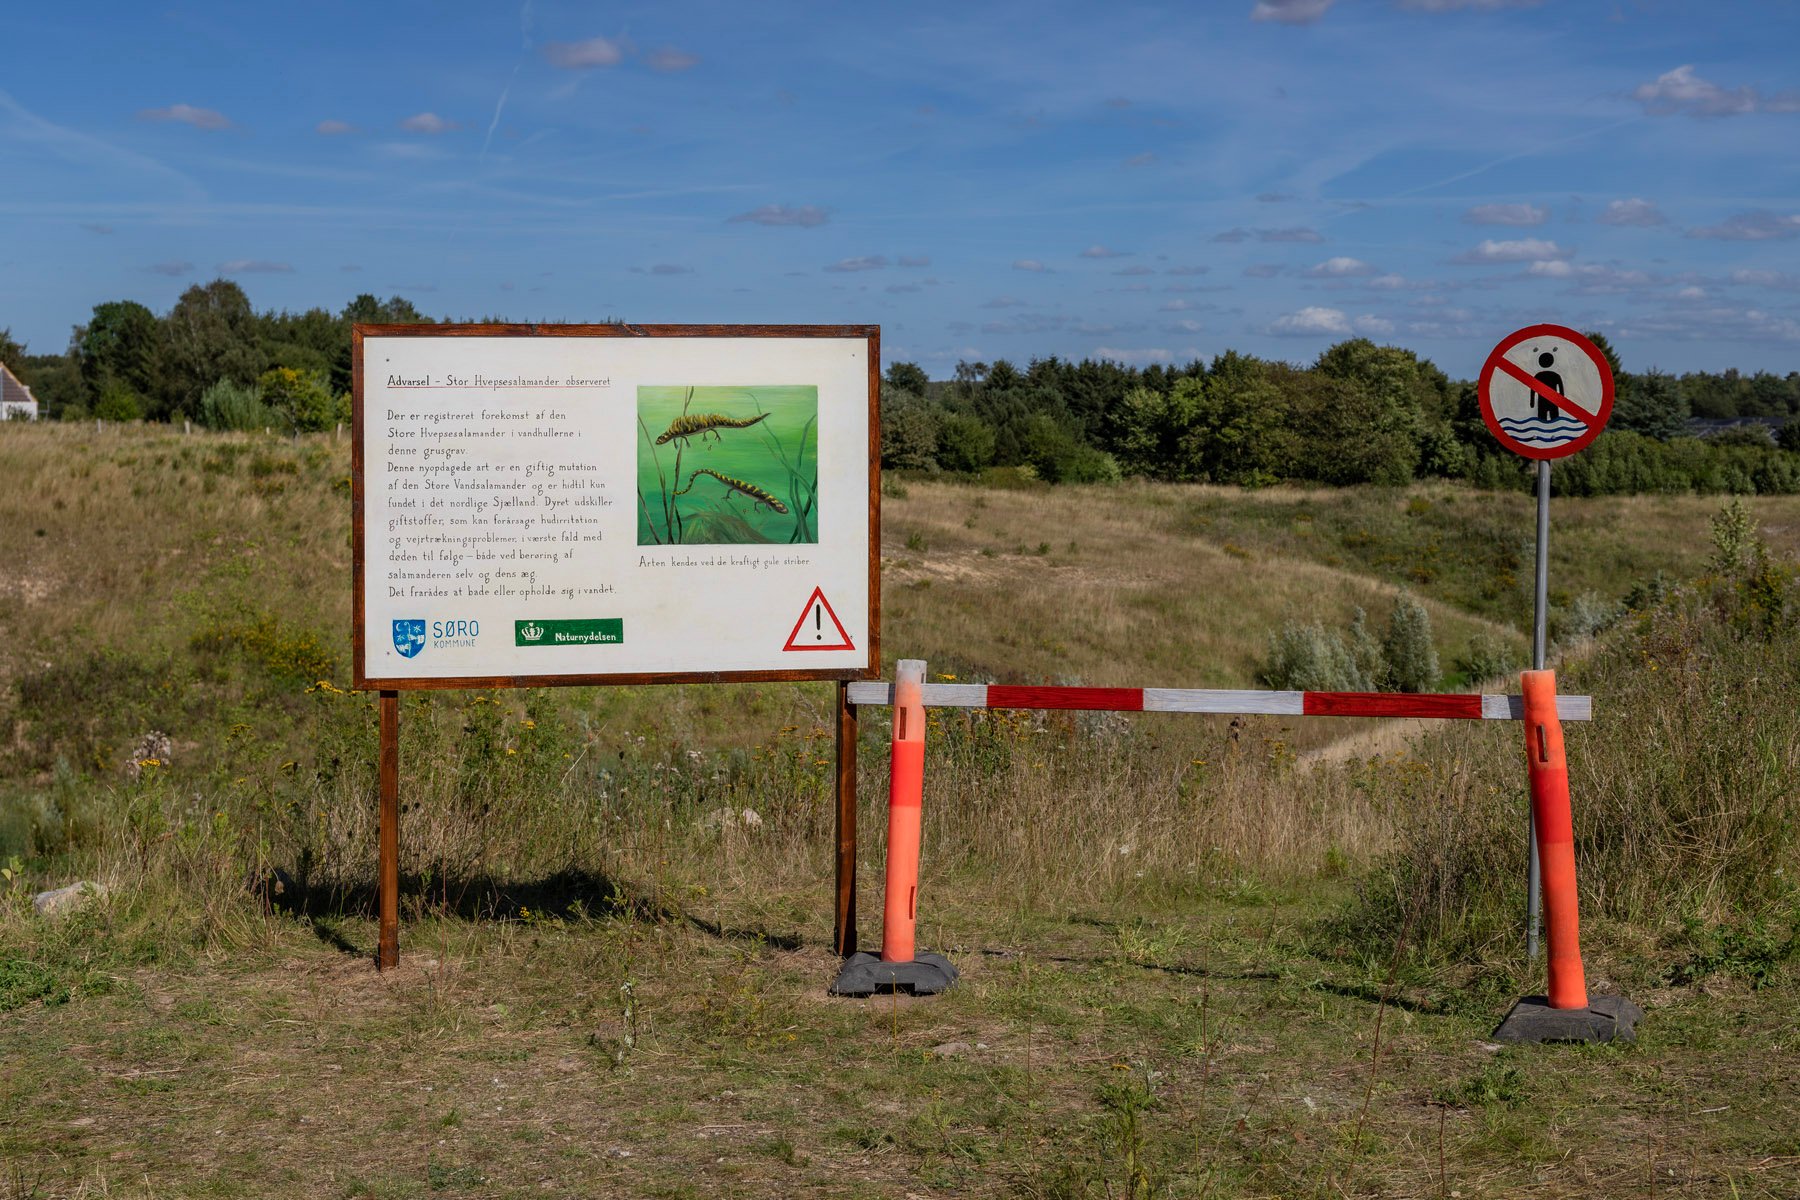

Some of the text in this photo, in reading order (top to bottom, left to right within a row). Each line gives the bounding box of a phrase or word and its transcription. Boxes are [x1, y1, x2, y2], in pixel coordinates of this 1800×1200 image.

[387, 375, 430, 386] Advarsel
[446, 375, 469, 386] Stor
[474, 375, 559, 390] Hvepsesalamander
[566, 374, 611, 386] observeret
[387, 409, 405, 420] Der
[424, 411, 474, 424] registreret
[482, 409, 529, 419] forekomst
[536, 409, 545, 419] af
[550, 409, 566, 420] den
[388, 427, 415, 437] Store
[421, 427, 505, 443] Hvepsesalamander
[518, 427, 574, 437] vandhullerne
[388, 443, 416, 455] denne
[388, 462, 414, 472] Denne
[419, 461, 471, 477] nyopdagede
[477, 462, 489, 471] art
[526, 461, 554, 477] giftig
[559, 463, 597, 471] mutation
[388, 479, 399, 490] af
[402, 479, 418, 489] den
[425, 479, 449, 489] Store
[454, 479, 526, 489] Vandsalamander
[532, 484, 543, 496] og
[563, 479, 584, 489] hidtil
[590, 479, 605, 488] kun
[389, 497, 416, 507] fundet
[430, 497, 444, 507] det
[450, 497, 488, 513] nordlige
[545, 496, 569, 510] Dyret
[575, 496, 612, 506] udskiller
[472, 514, 488, 524] kan
[494, 514, 535, 529] forårsage
[541, 514, 597, 524] hudirritation
[389, 537, 401, 549] og
[527, 534, 556, 542] værste
[562, 531, 578, 541] fald
[584, 531, 602, 541] med
[389, 550, 417, 561] døden
[423, 550, 433, 560] til
[440, 550, 463, 566] følge
[476, 549, 496, 560] både
[500, 549, 515, 559] ved
[519, 549, 558, 563] berøring
[564, 548, 573, 558] af
[639, 556, 665, 567] Arten
[672, 556, 697, 566] kendes
[701, 556, 714, 566] ved
[717, 556, 726, 565] de
[731, 555, 759, 569] kraftigt
[764, 556, 779, 569] gule
[388, 568, 451, 579] salamanderen
[456, 568, 473, 578] selv
[479, 572, 490, 584] og
[495, 567, 516, 578] dens
[389, 586, 404, 597] Det
[411, 586, 448, 597] frarådes
[453, 587, 462, 596] at
[468, 585, 489, 596] bade
[494, 585, 515, 595] eller
[520, 585, 555, 601] opholde
[561, 589, 574, 600] sig
[433, 620, 479, 638] SØRO
[555, 631, 617, 643] Naturnydelsen
[433, 639, 476, 648] KOMMUNE
